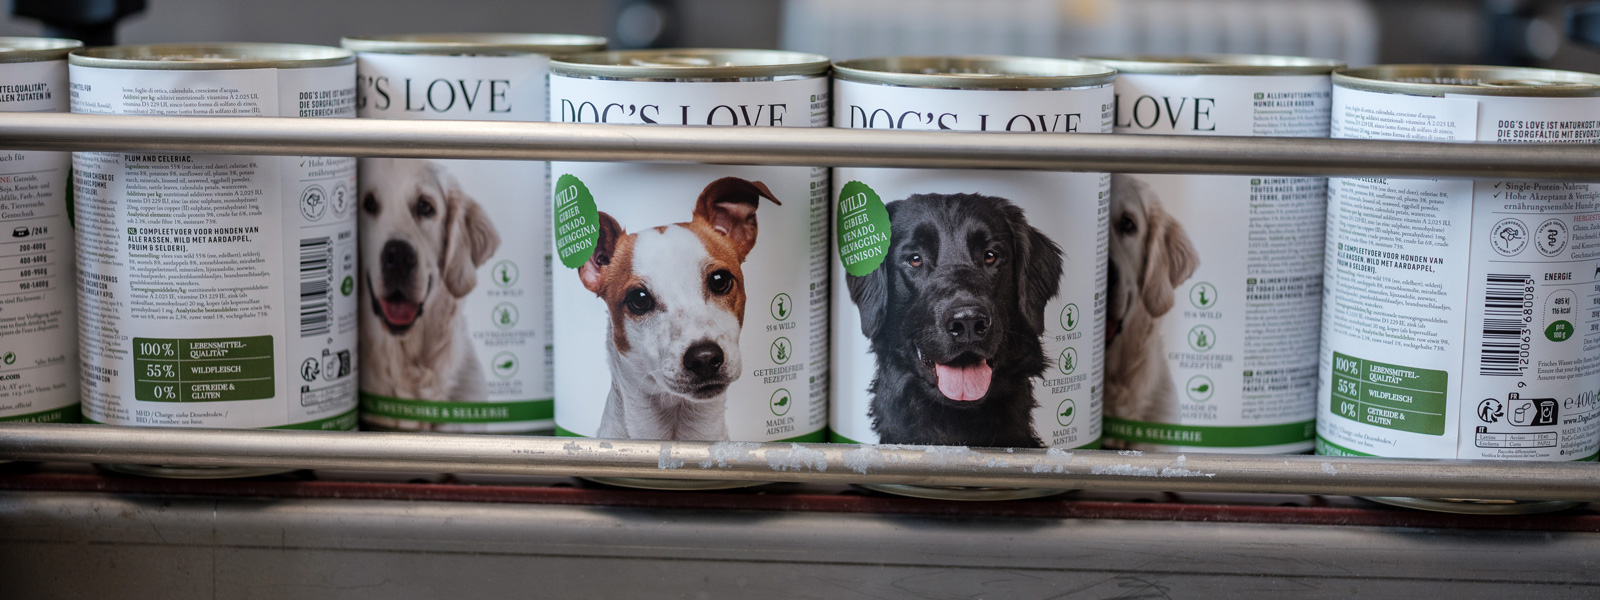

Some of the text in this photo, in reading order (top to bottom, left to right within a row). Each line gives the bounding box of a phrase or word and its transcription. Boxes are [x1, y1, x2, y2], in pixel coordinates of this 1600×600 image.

[17, 92, 43, 101] ZUTATEN
[300, 91, 332, 100] DOG'S LOVE
[404, 78, 512, 113] LOVE
[1114, 94, 1216, 131] LOVE
[1499, 120, 1595, 129] DOG'S LOVE IST NATURKOST
[1514, 129, 1559, 138] SORGFÄLTIG
[1506, 182, 1589, 192] Single-Protein-Nahrung
[556, 185, 577, 208] WILD
[1505, 192, 1527, 200] Hohe
[1529, 193, 1566, 202] Akzeptanz
[840, 192, 867, 215] WILD
[1504, 202, 1573, 212] ernährungssensible
[560, 206, 580, 223] GIBIER
[559, 216, 585, 236] VENADO
[844, 213, 869, 230] GIBIER
[558, 224, 596, 249] SELVAGGINA
[843, 224, 875, 242] VENADO
[208, 235, 251, 243] AARDAPPEL,
[841, 232, 887, 256] SELVAGGINA
[155, 244, 188, 252] SELDERIJ.
[561, 238, 592, 258] VENISON
[1344, 244, 1381, 258] COMPLEETVOER
[1383, 251, 1399, 260] VOOR
[1400, 254, 1428, 263] HONDEN
[845, 246, 882, 266] VENISON
[1346, 253, 1365, 262] RASSEN.
[1381, 259, 1392, 267] MET
[1394, 260, 1436, 274] AARDAPPEL,
[1352, 264, 1377, 274] SELDERIJ.
[1545, 272, 1572, 280] ENERGIE
[1523, 279, 1535, 323] 680085
[779, 322, 796, 331] WILD
[1067, 332, 1082, 340] WILD
[190, 341, 246, 349] LEBENSMITTEL-
[1519, 329, 1531, 371] 120063
[191, 366, 241, 374] WILDFLEISCH
[754, 363, 804, 377] GETREIDEFREIE
[1179, 361, 1223, 370] REZEPTUR
[1370, 364, 1420, 379] LEBENSMITTEL-
[764, 373, 797, 384] REZEPTUR
[1043, 373, 1087, 387] GETREIDEFREIE
[1052, 383, 1081, 394] REZEPTUR
[1369, 389, 1412, 403] WILDFLEISCH
[453, 407, 509, 419] SELLERIE
[1181, 412, 1217, 420] AUSTRIA
[1368, 406, 1398, 420] GETREIDE
[766, 418, 785, 427] MADE
[1367, 415, 1392, 425] GLUTEN
[766, 425, 794, 435] AUSTRIA
[1052, 429, 1071, 437] MADE
[1136, 427, 1202, 442] & SELLERIE
[1052, 435, 1077, 445] AUSTRIA
